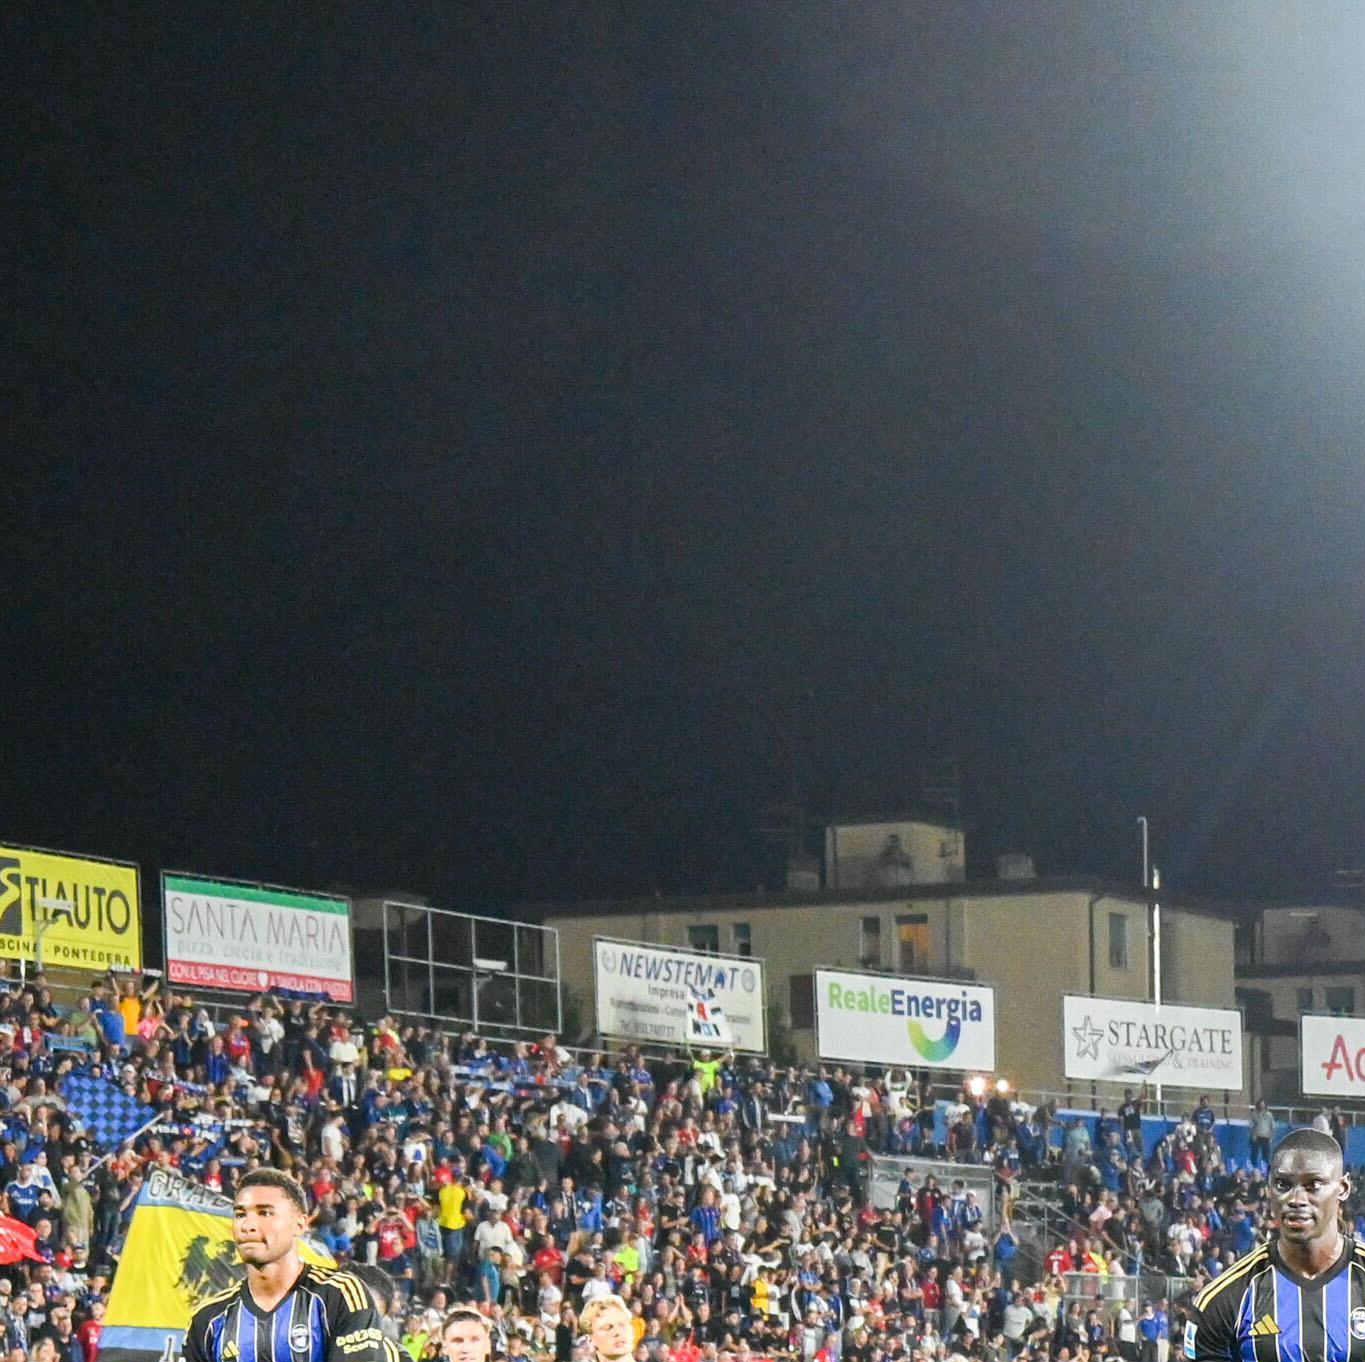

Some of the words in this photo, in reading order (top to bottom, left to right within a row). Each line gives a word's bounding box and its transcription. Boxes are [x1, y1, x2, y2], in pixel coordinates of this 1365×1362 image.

[171, 896, 258, 943] SANTA
[267, 911, 345, 952] MARIA
[54, 945, 131, 965] PONTEDERA
[1107, 1019, 1233, 1055] STARGATE
